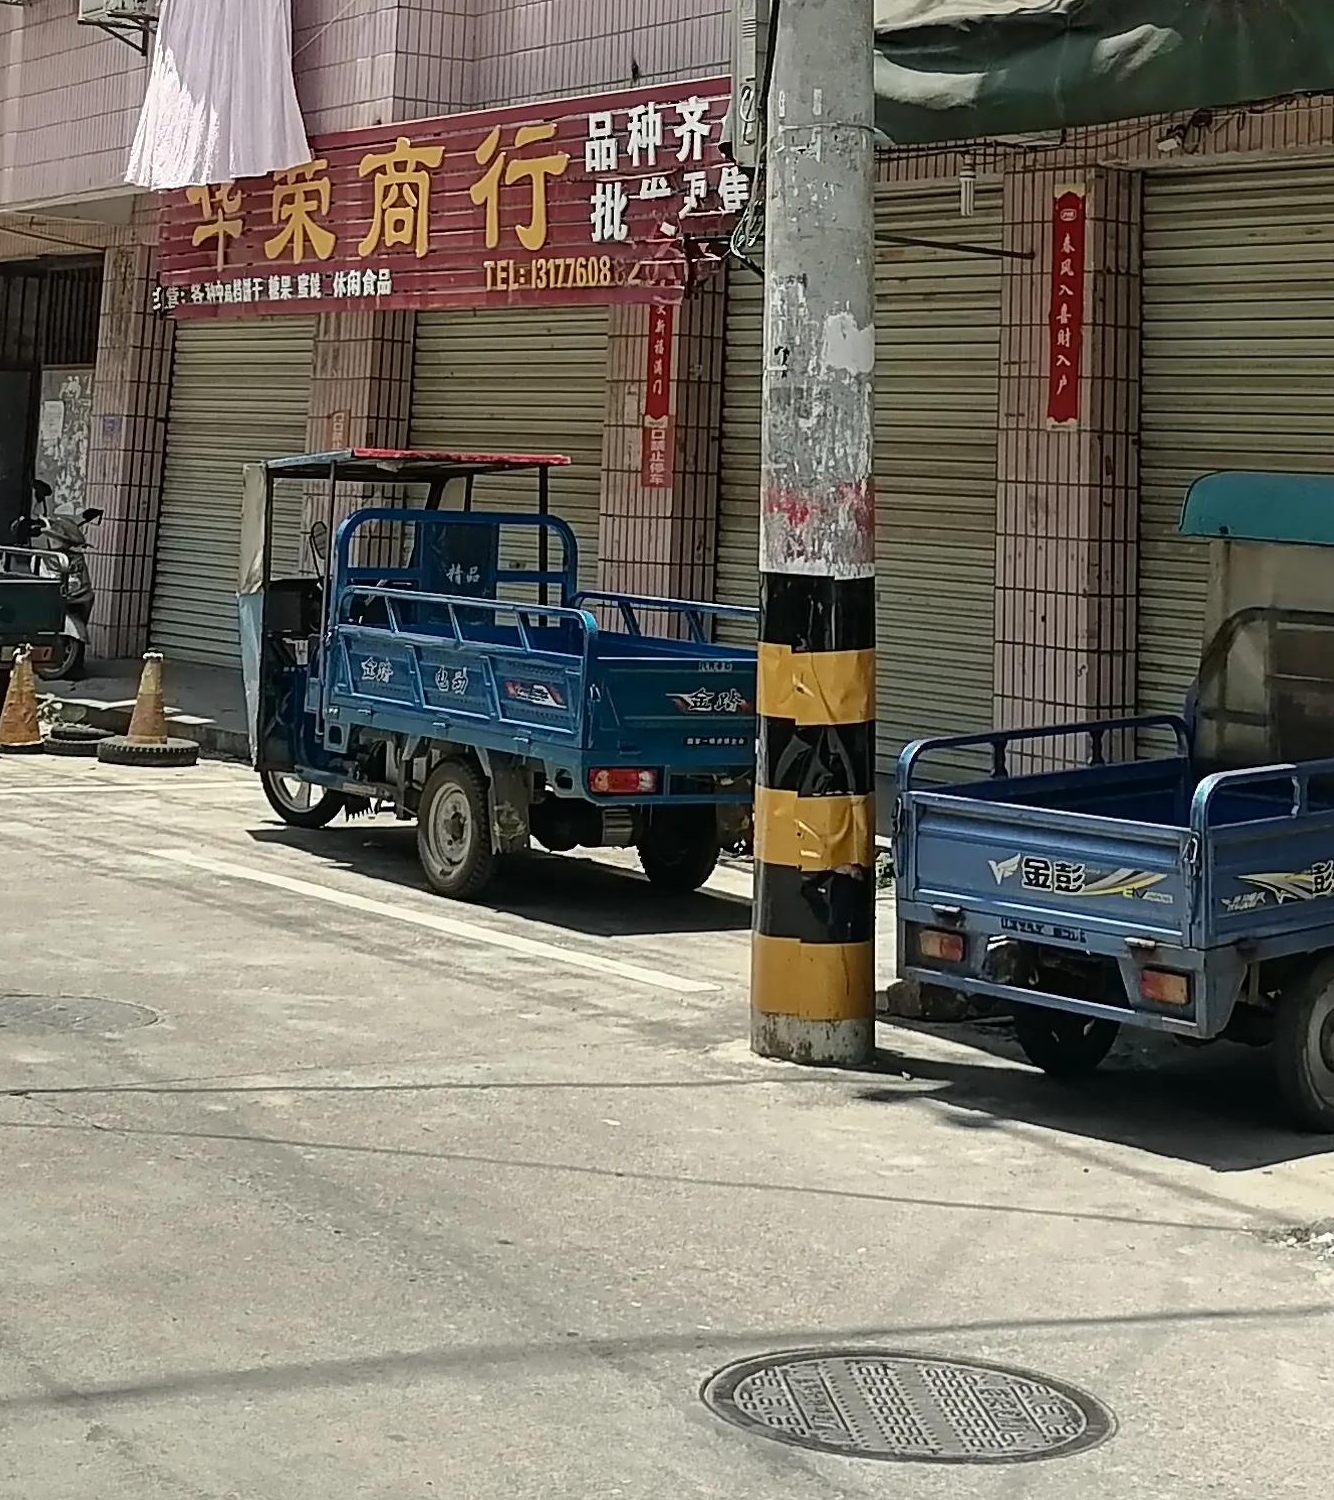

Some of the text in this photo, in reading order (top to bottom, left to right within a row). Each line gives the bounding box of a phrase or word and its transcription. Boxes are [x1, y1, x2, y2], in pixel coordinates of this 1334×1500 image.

[585, 96, 733, 173] 品种齐
[186, 123, 571, 273] 华荣商行
[1021, 855, 1086, 896] 金彭
